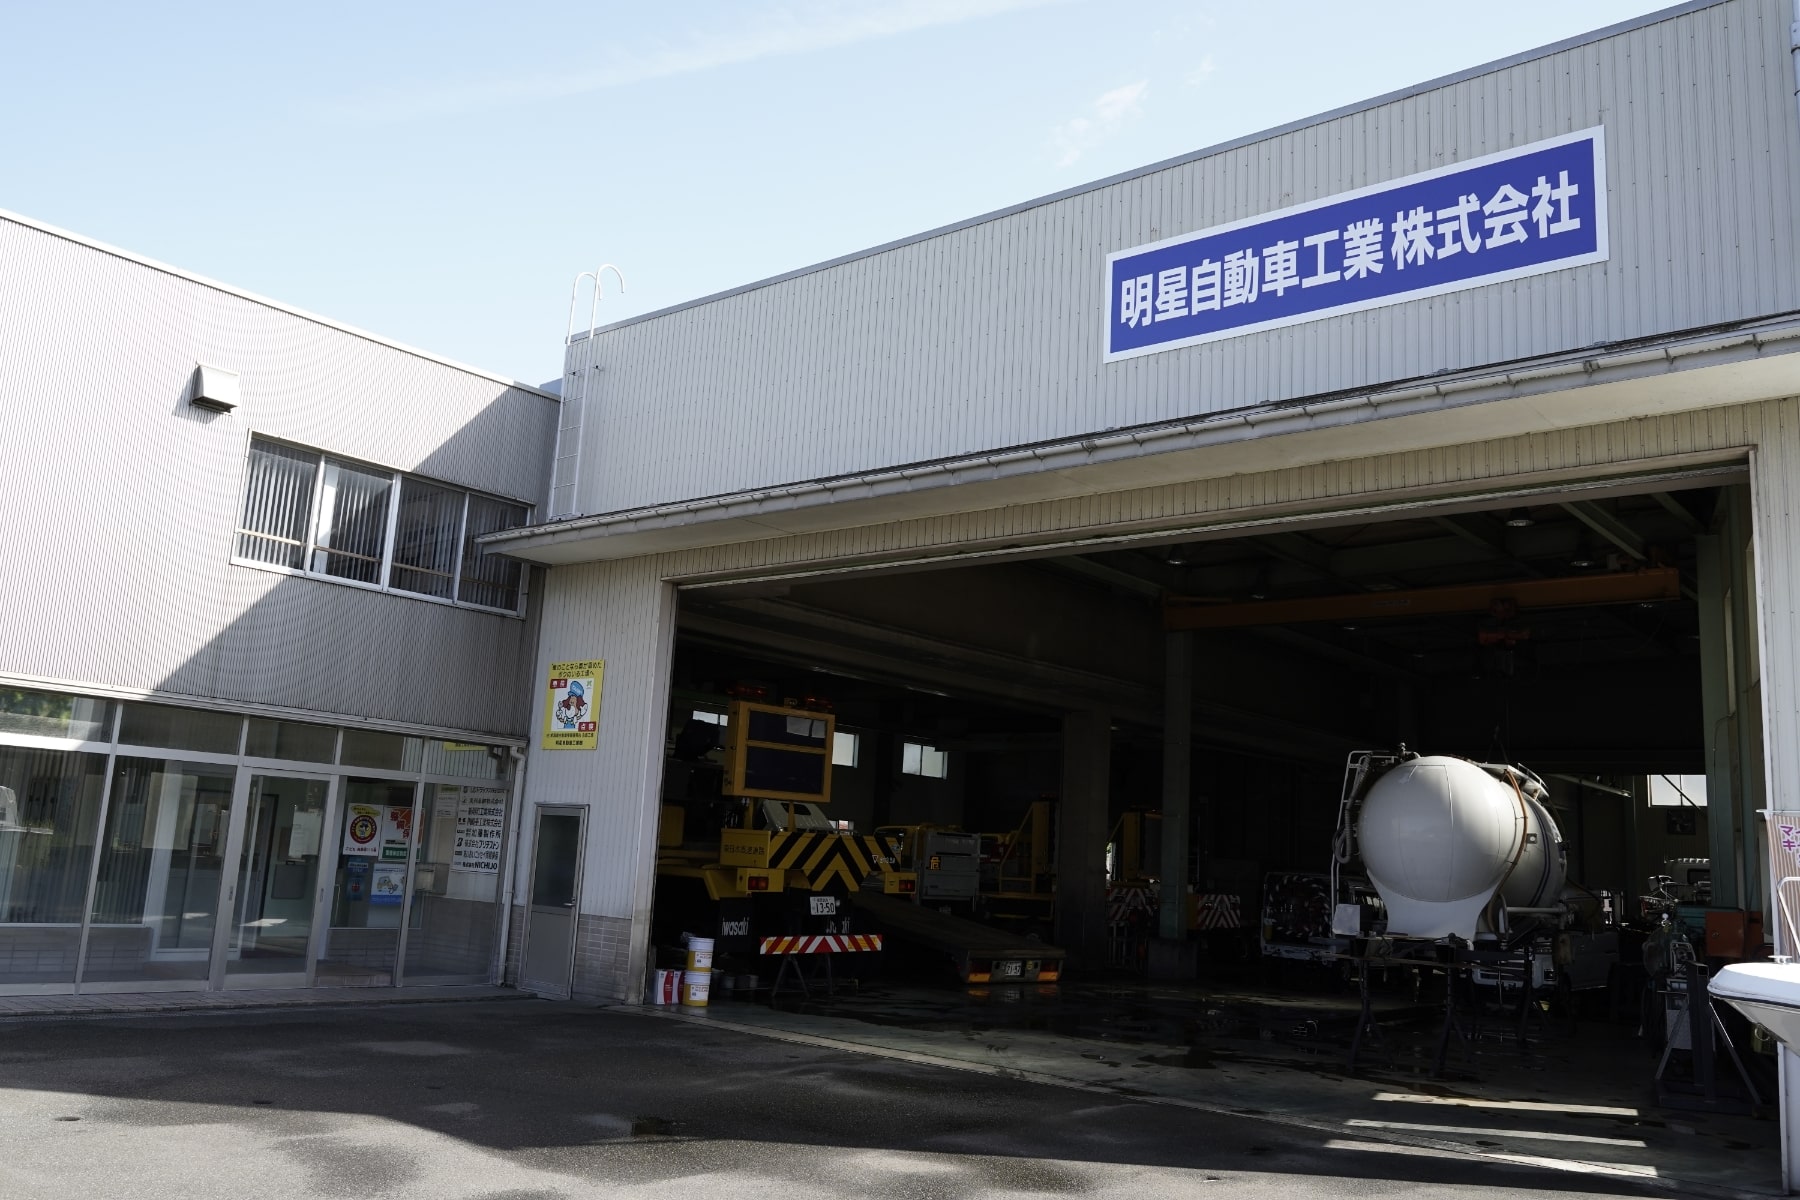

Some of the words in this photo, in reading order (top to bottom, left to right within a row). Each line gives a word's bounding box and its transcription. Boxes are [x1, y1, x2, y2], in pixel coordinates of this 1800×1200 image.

[1119, 170, 1582, 330] 明星自動車工業株式会社
[930, 856, 941, 869] 危
[721, 915, 750, 936] iwasaki
